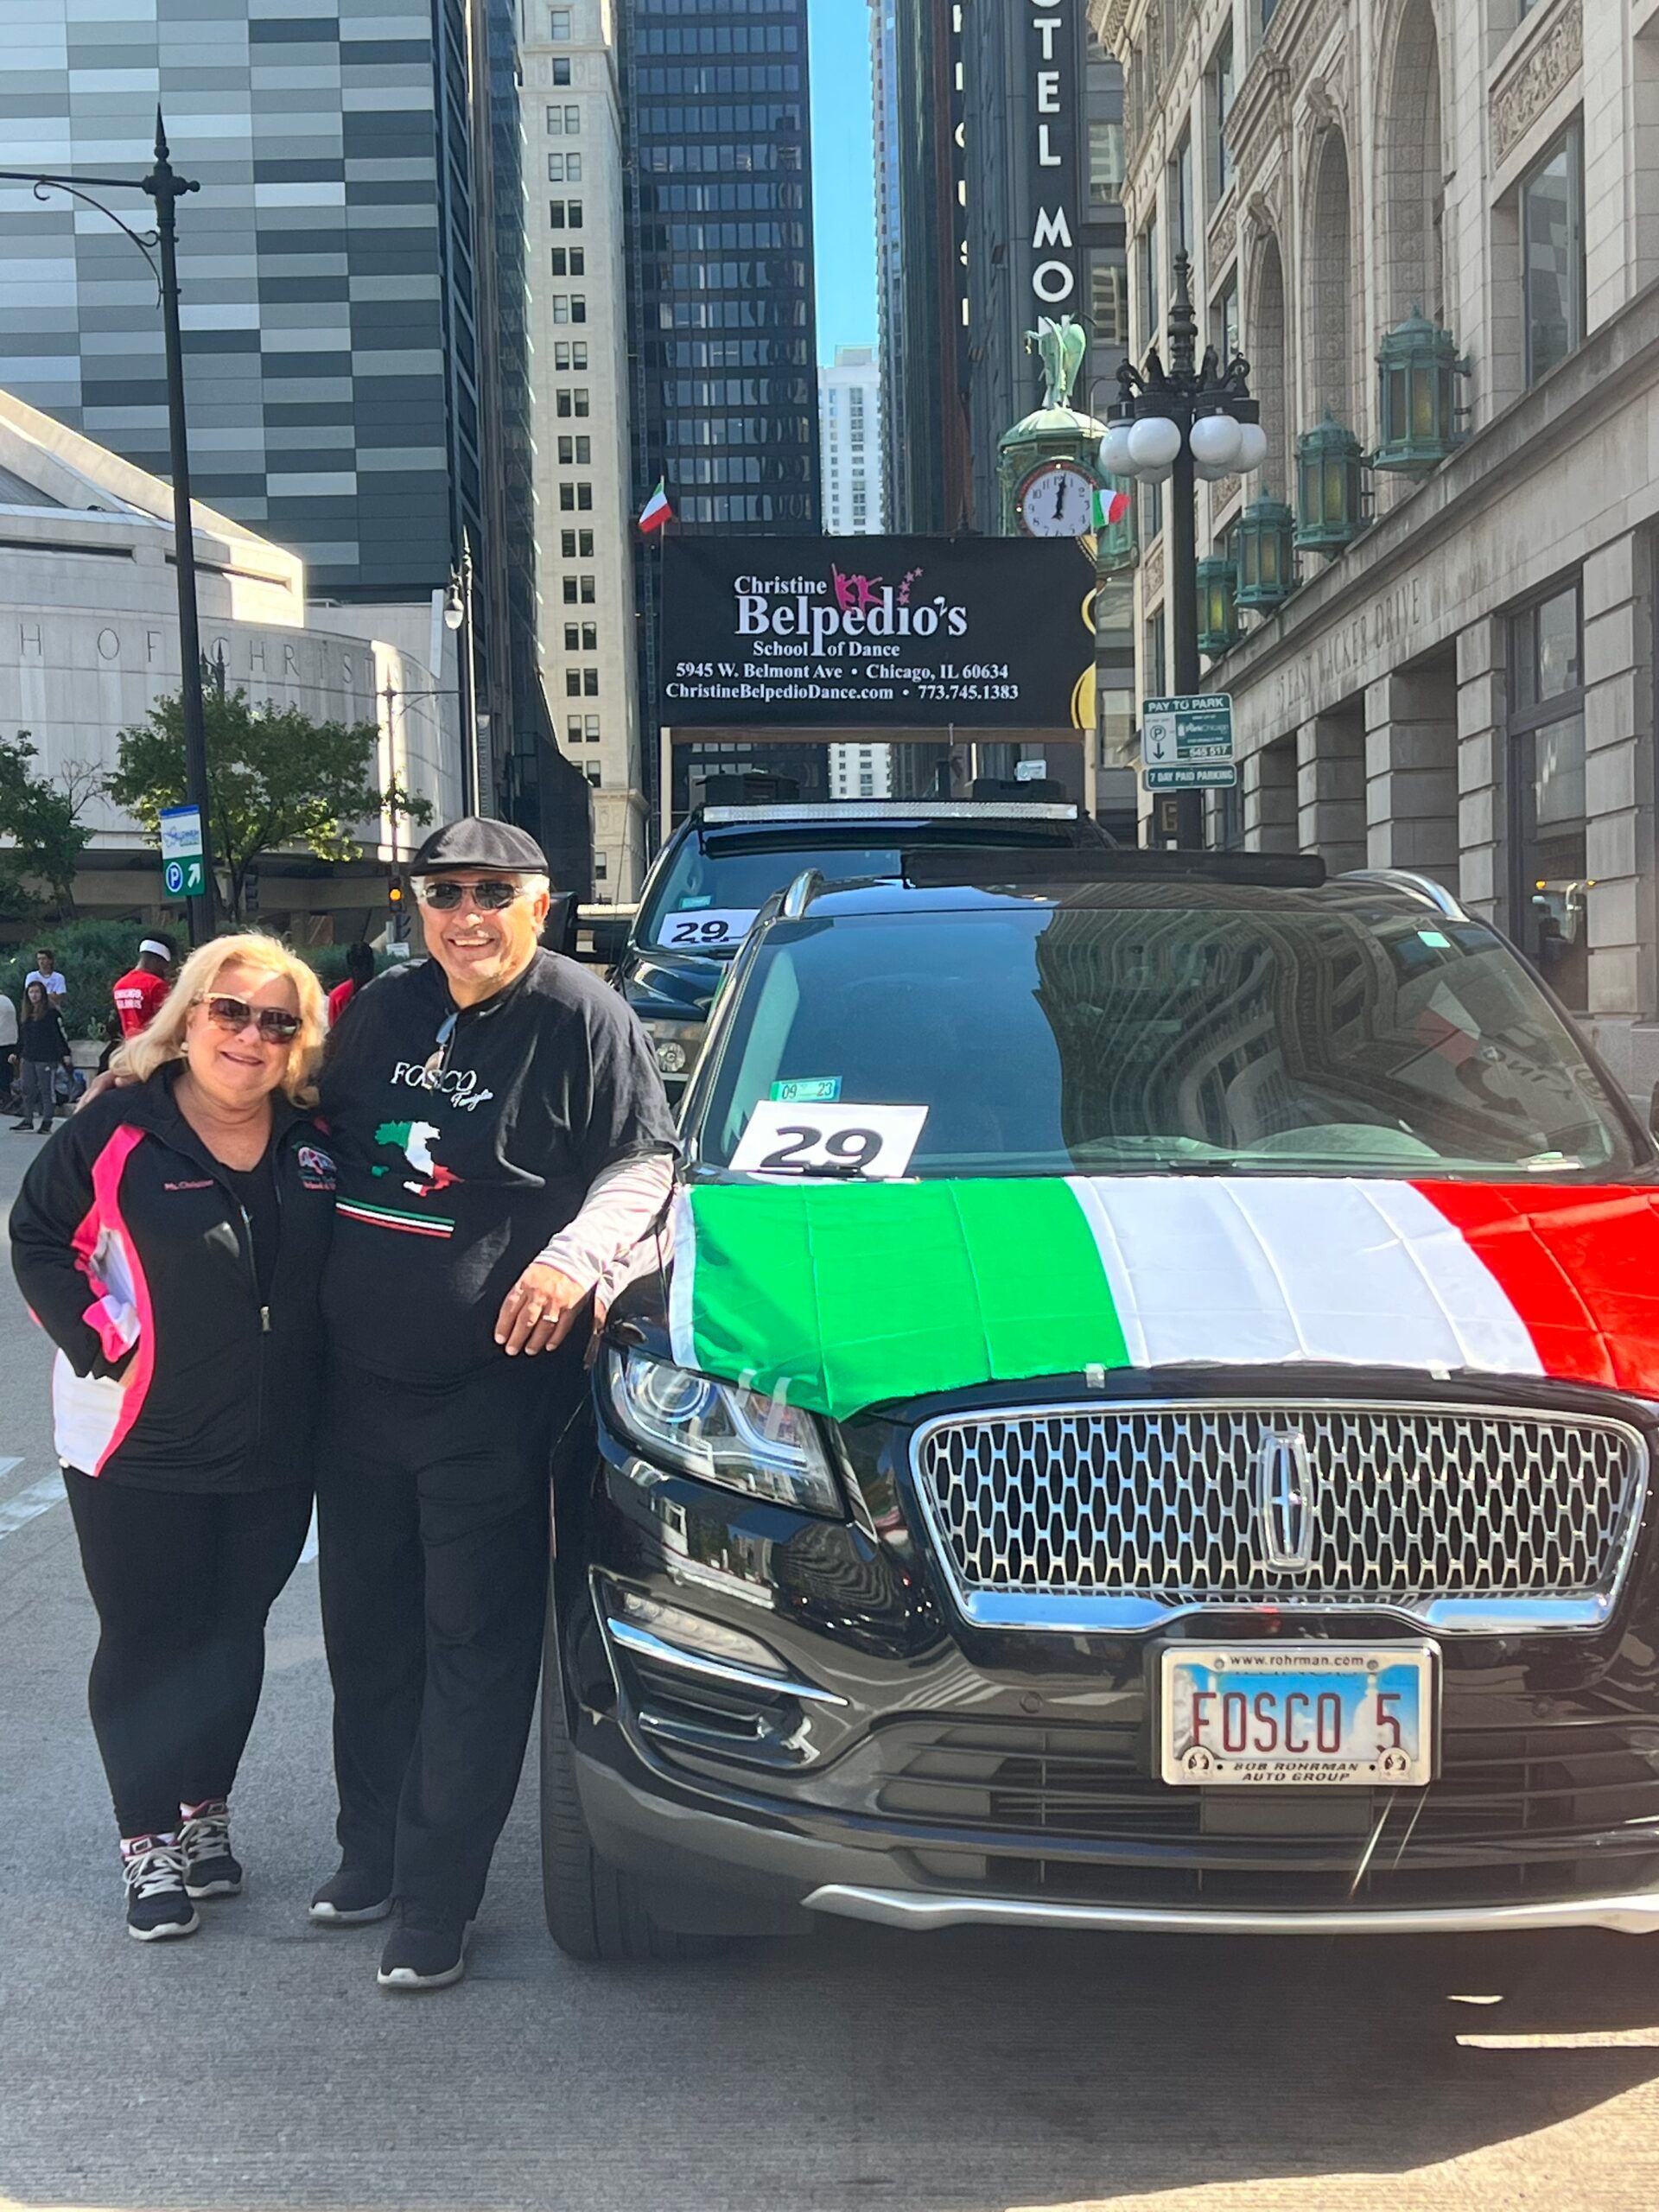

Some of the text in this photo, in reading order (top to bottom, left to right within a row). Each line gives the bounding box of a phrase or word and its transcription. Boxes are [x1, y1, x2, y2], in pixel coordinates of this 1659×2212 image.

[1031, 0, 1063, 166] TEL
[734, 575, 827, 595] Christine
[734, 585, 969, 657] Belpedio's
[1375, 577, 1420, 649] DRIVE
[96, 627, 162, 664] OF
[753, 640, 900, 657] School of Dance
[676, 662, 1008, 682] 5945 W. Belmont Ave Chicago, IL 60634
[665, 683, 1020, 702] ChristineBelpedioDance.com 773.745.1383
[1147, 697, 1224, 713] PAY TO PARK
[1149, 770, 1234, 783] 7 DAY PAID PARKING
[671, 920, 729, 944] 29
[782, 1081, 833, 1100] 09 23
[759, 1125, 884, 1169] 29
[1230, 1654, 1364, 1667] www.rohrman.com
[1192, 1691, 1402, 1753] FOSCO 5
[1233, 1762, 1359, 1771] BOB ROHRMAN
[1242, 1772, 1351, 1782] AUTO GROUP
